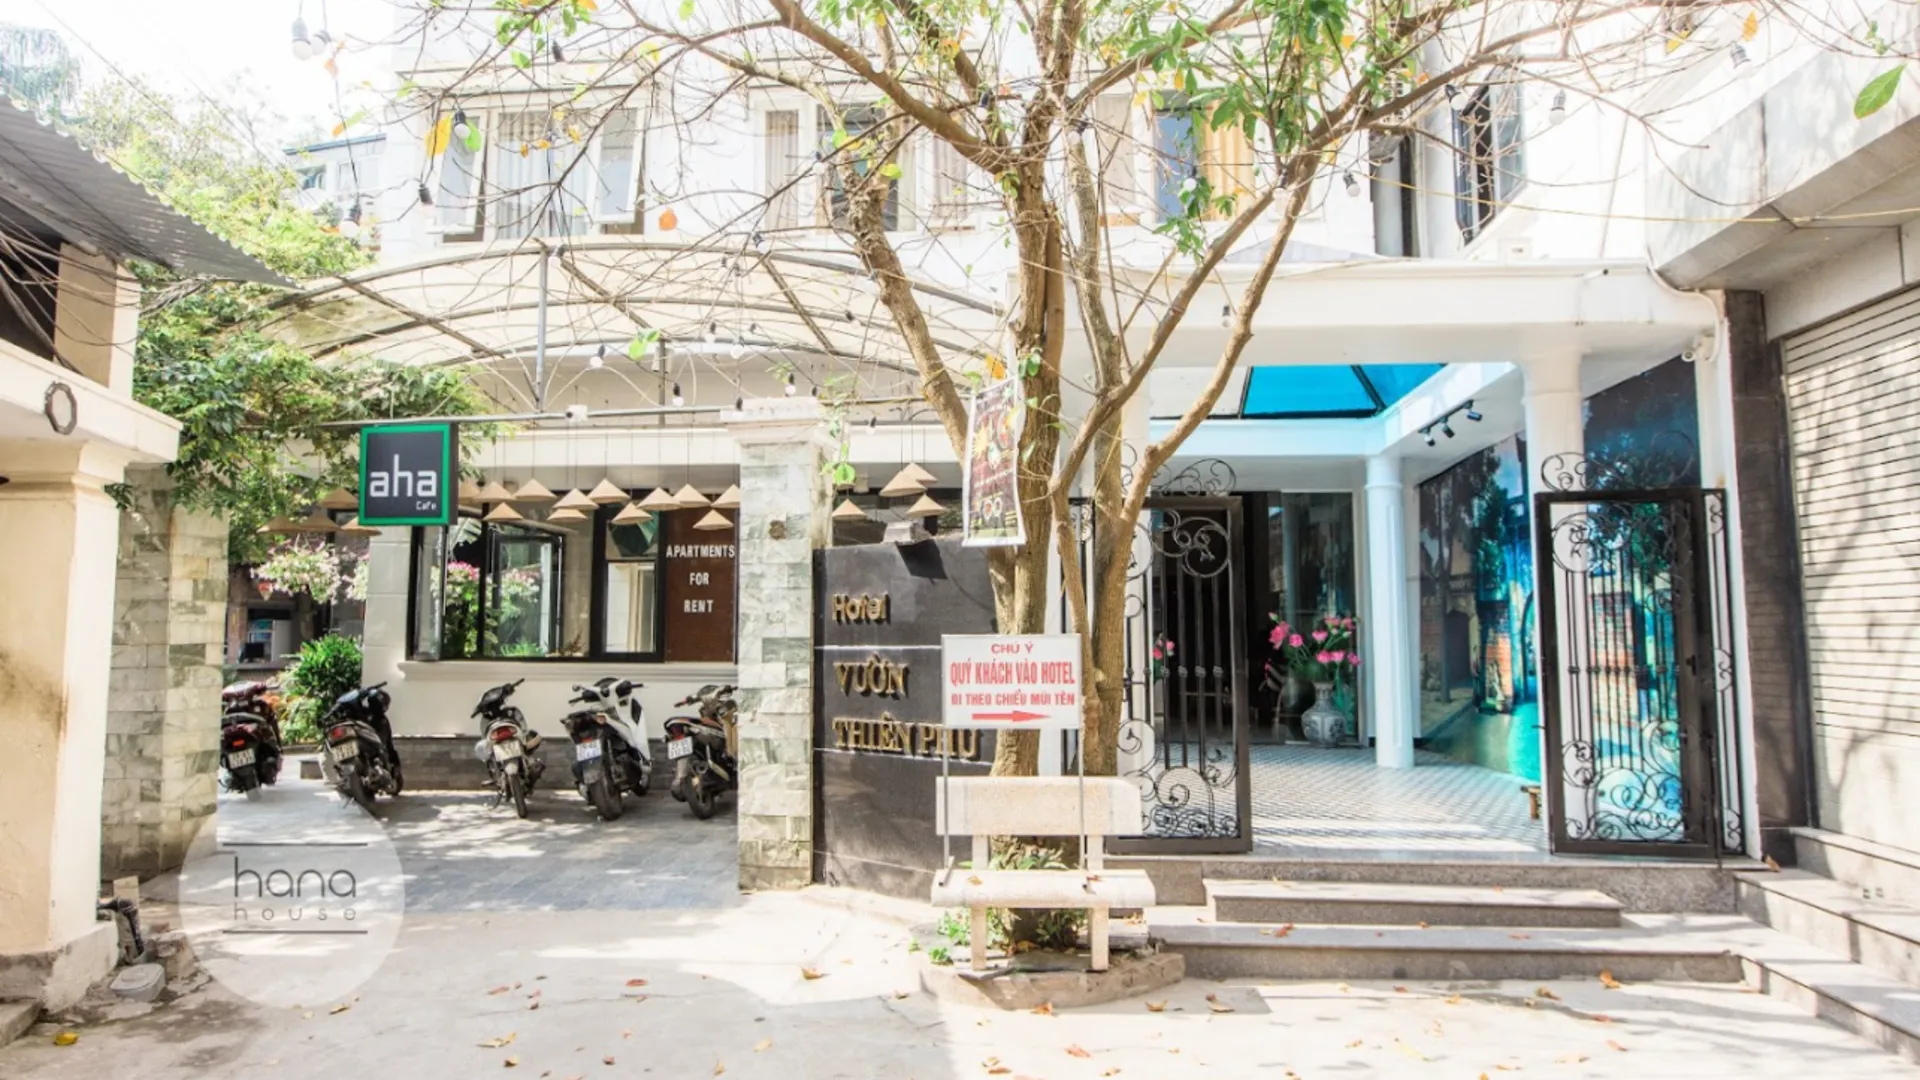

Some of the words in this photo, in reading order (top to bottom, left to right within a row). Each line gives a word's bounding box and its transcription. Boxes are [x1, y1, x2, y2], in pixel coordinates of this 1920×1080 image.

[369, 453, 437, 497] aha
[666, 544, 735, 558] APARTMENTS
[689, 572, 710, 586] FOR
[683, 599, 714, 613] RENT
[832, 591, 888, 621] Hotel
[950, 657, 972, 687] QUÝ
[975, 658, 1013, 684] KHÁCH
[1015, 659, 1038, 684] VÀO
[1041, 662, 1076, 684] HOTEL
[966, 693, 992, 705] THEO
[1055, 690, 1075, 705] TÊN
[832, 711, 913, 752] THIÊN
